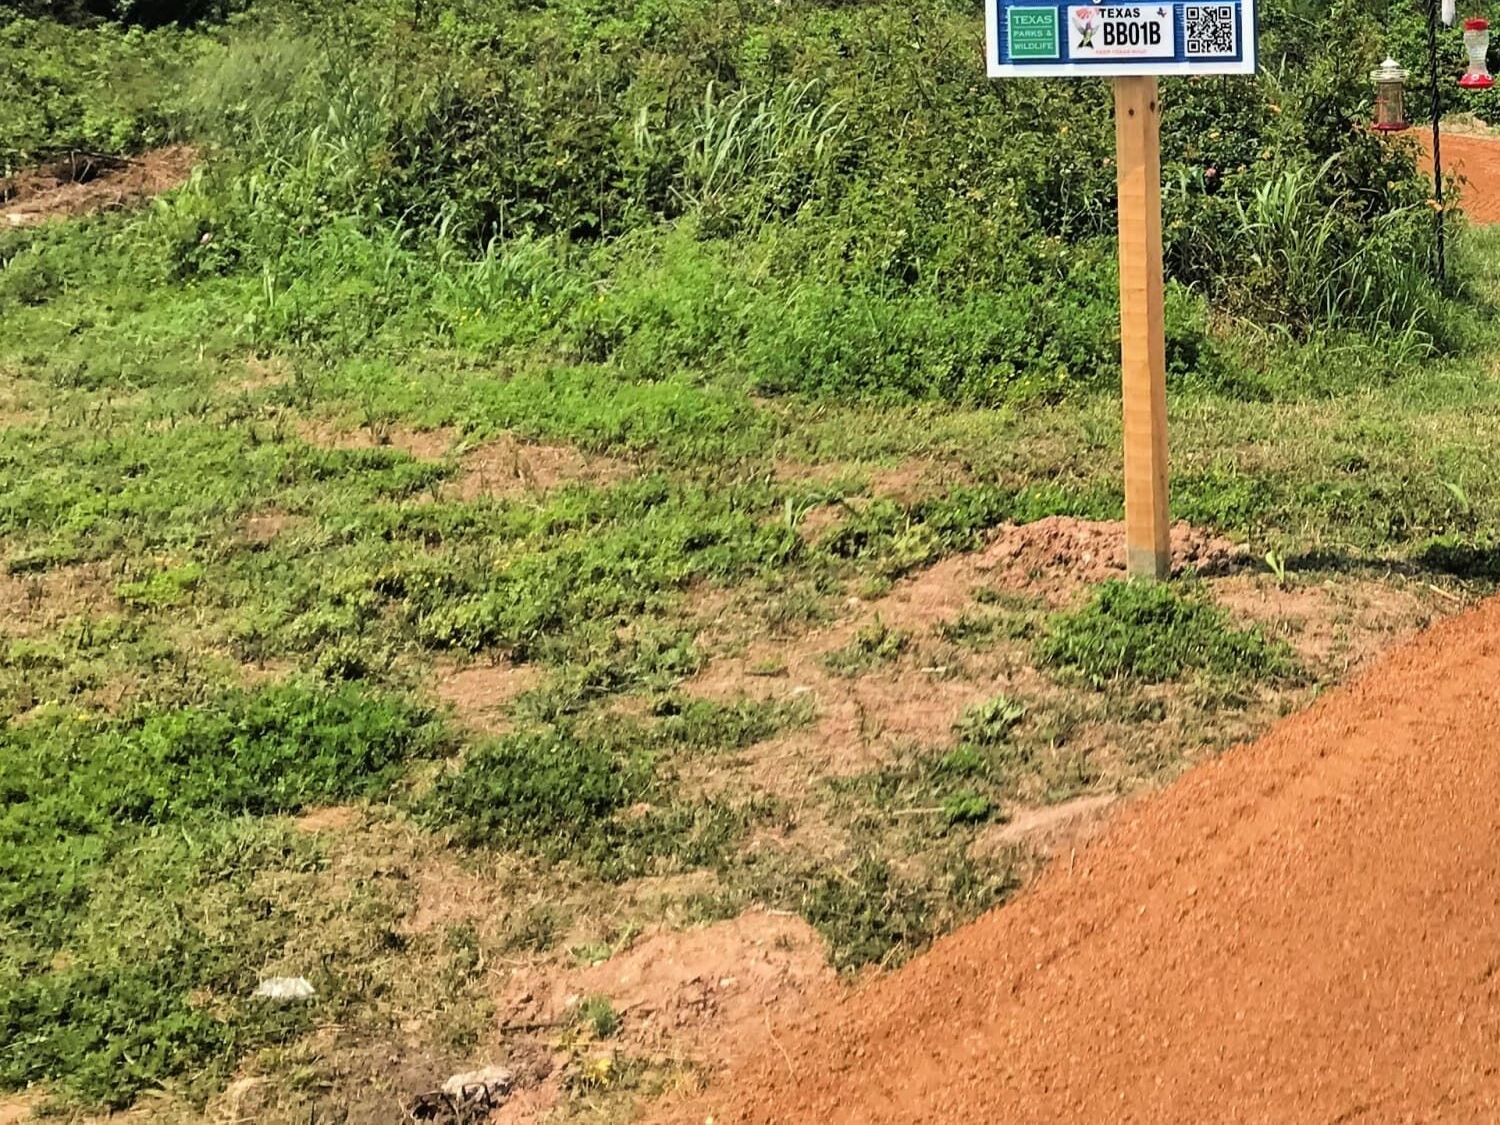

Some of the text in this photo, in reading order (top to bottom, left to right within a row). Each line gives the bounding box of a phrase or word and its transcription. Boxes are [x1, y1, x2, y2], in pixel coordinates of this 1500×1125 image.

[1099, 7, 1141, 19] TEXAS
[1013, 15, 1053, 25] TEXAS
[1013, 29, 1043, 38] PARKS
[1103, 20, 1162, 46] BB01B
[1013, 41, 1054, 51] WILDLIFE
